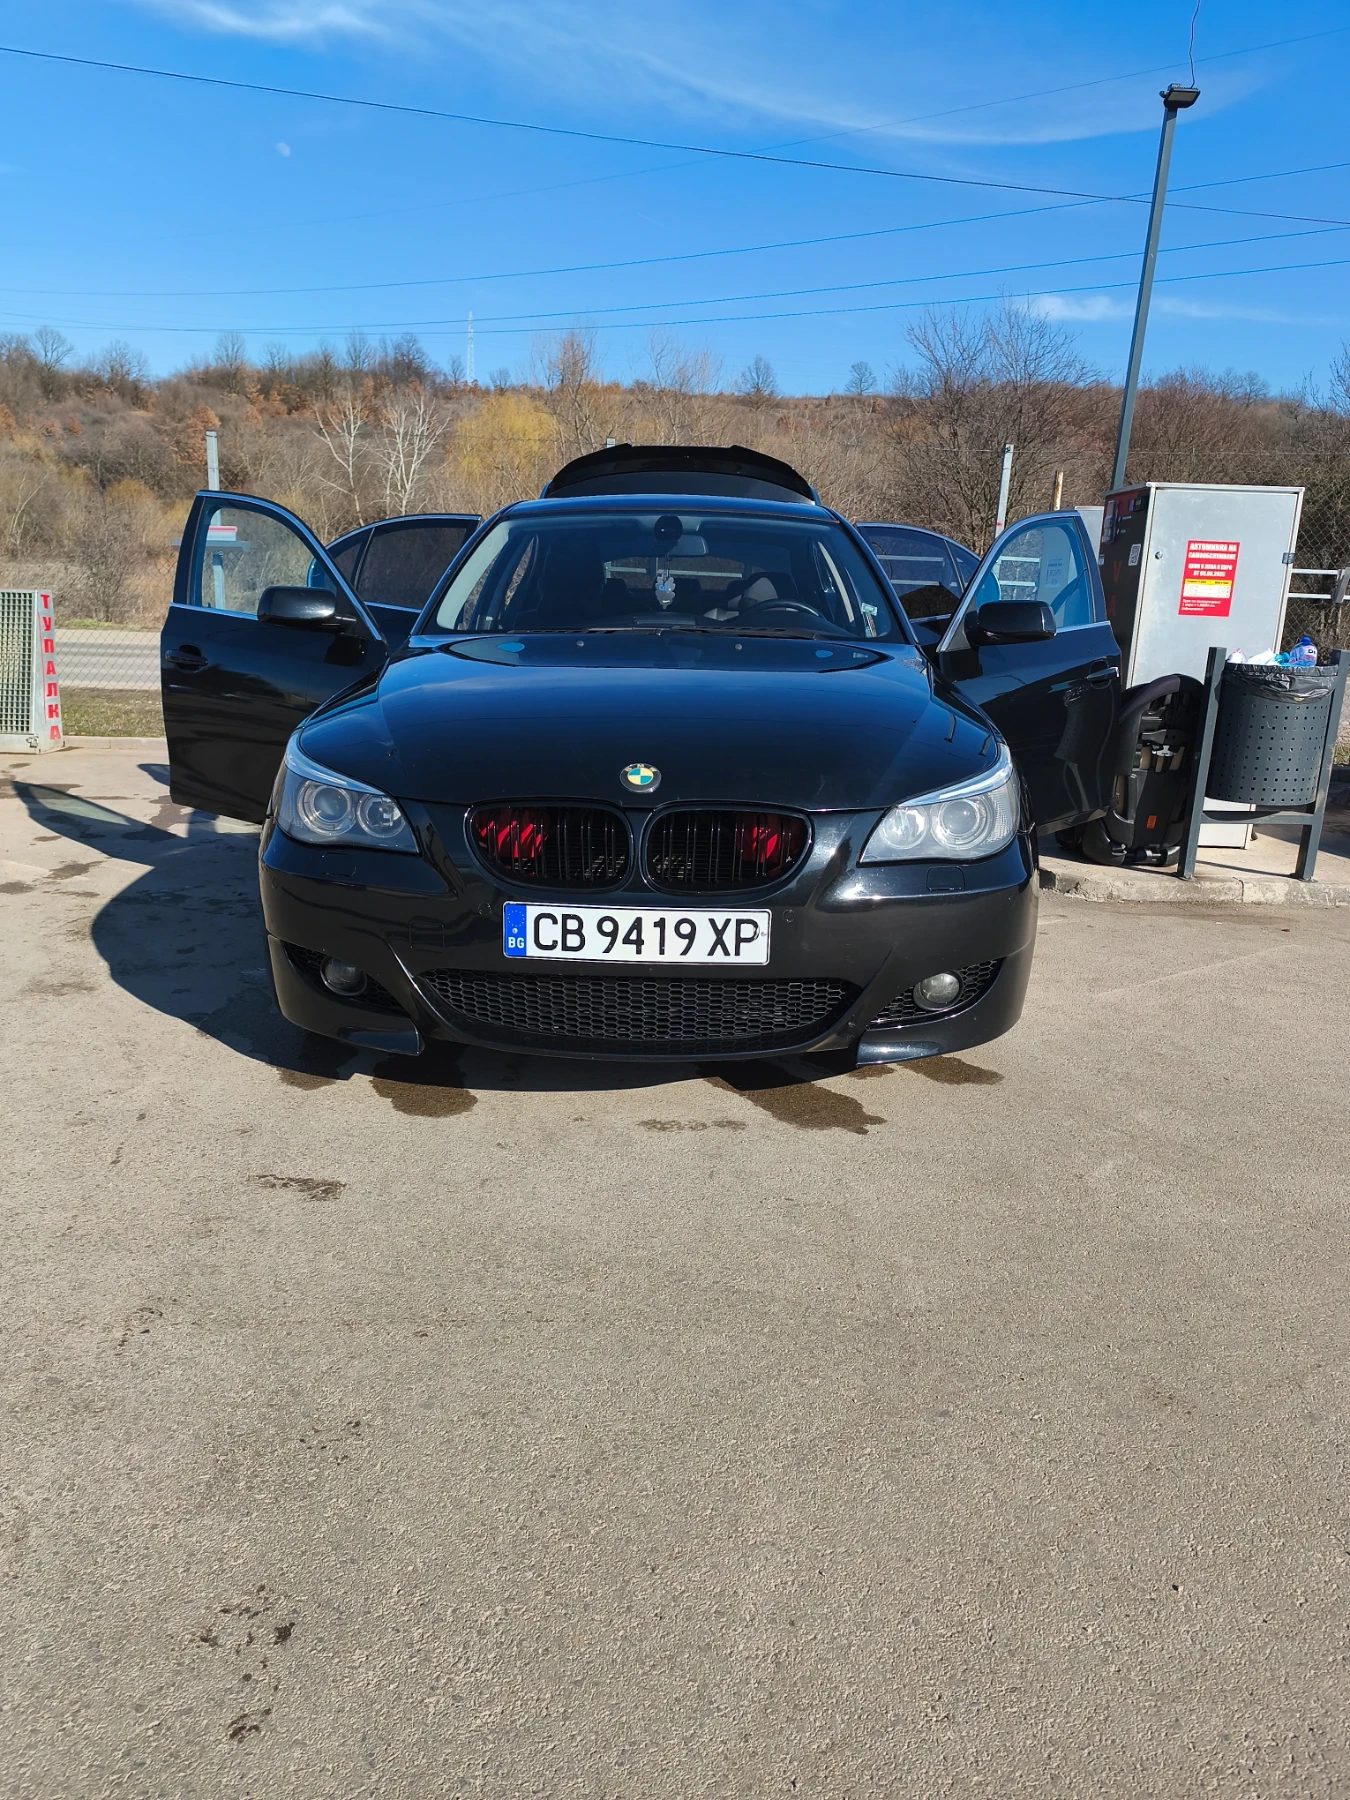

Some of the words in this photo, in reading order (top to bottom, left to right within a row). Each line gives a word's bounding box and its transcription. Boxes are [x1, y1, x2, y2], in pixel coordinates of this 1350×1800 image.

[40, 594, 61, 740] ТУПАЛКА
[508, 936, 525, 949] BG
[533, 912, 586, 952] CB
[596, 915, 697, 956] 9419
[706, 918, 760, 957] XP
